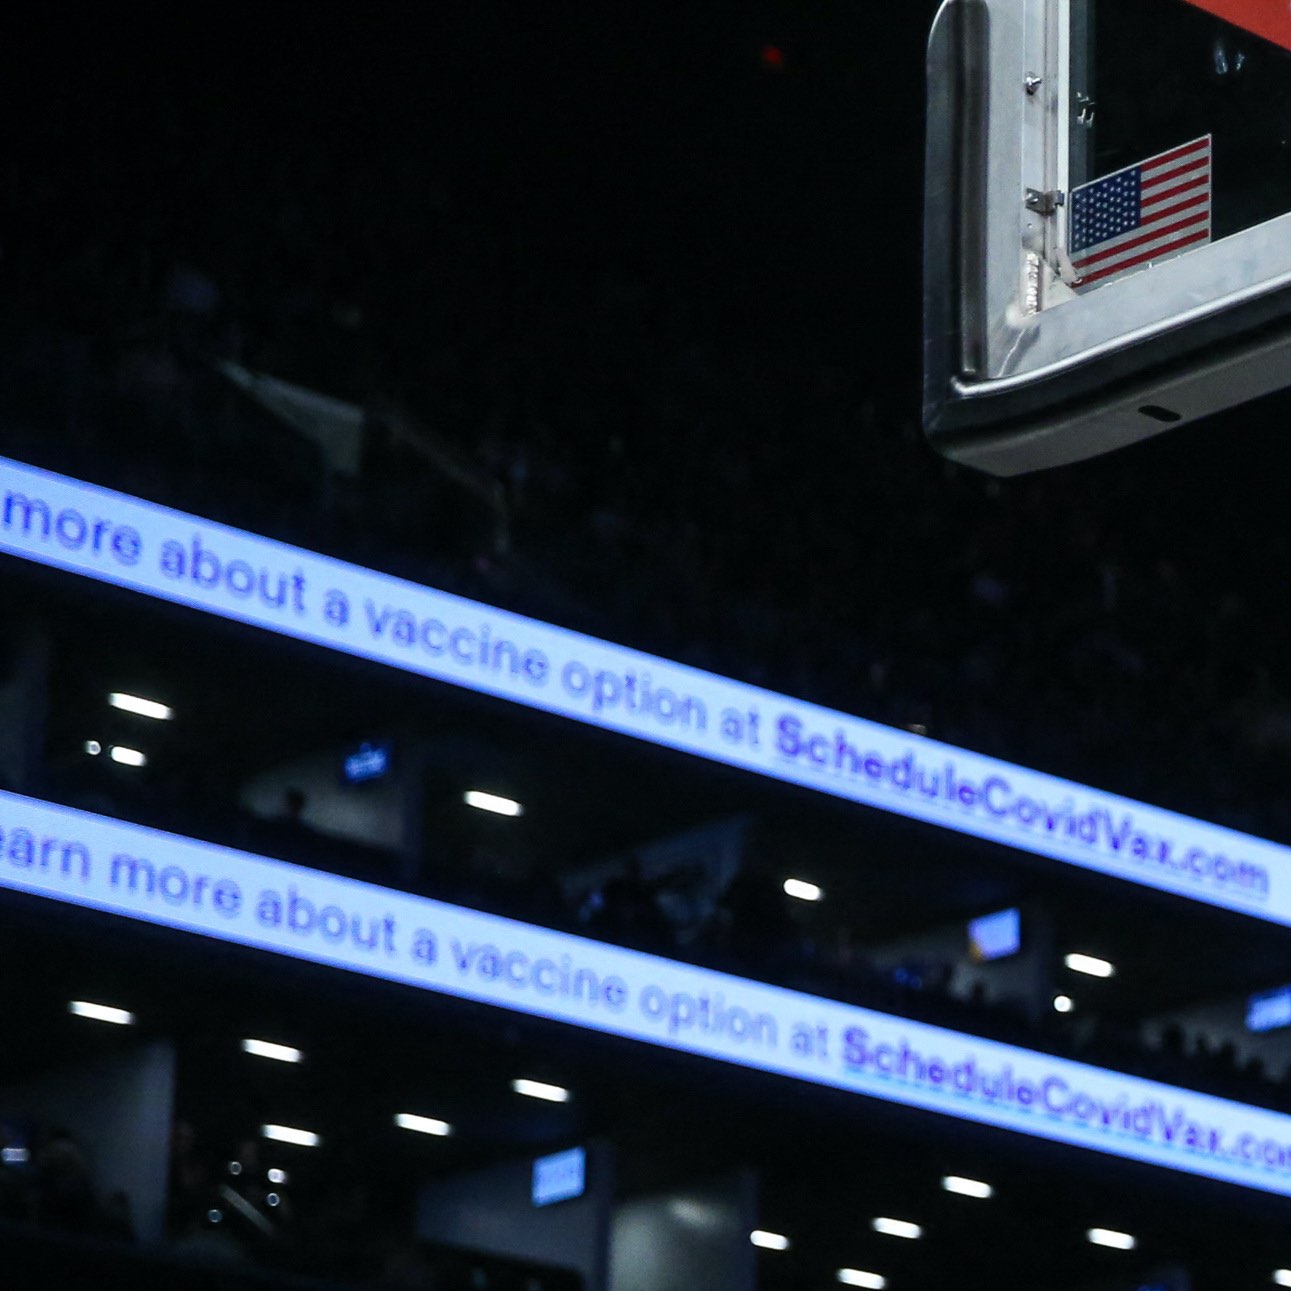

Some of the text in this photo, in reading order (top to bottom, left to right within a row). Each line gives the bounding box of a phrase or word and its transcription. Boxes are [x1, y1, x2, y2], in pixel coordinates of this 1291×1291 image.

[2, 488, 1271, 897] more about a vaccine option at ScheduleCovidVax.com
[0, 826, 92, 882] arn
[109, 852, 244, 920] more
[254, 881, 399, 955] about
[410, 927, 440, 968] a
[449, 937, 630, 1014] vaccine
[638, 983, 779, 1050] option
[788, 1016, 831, 1061] at
